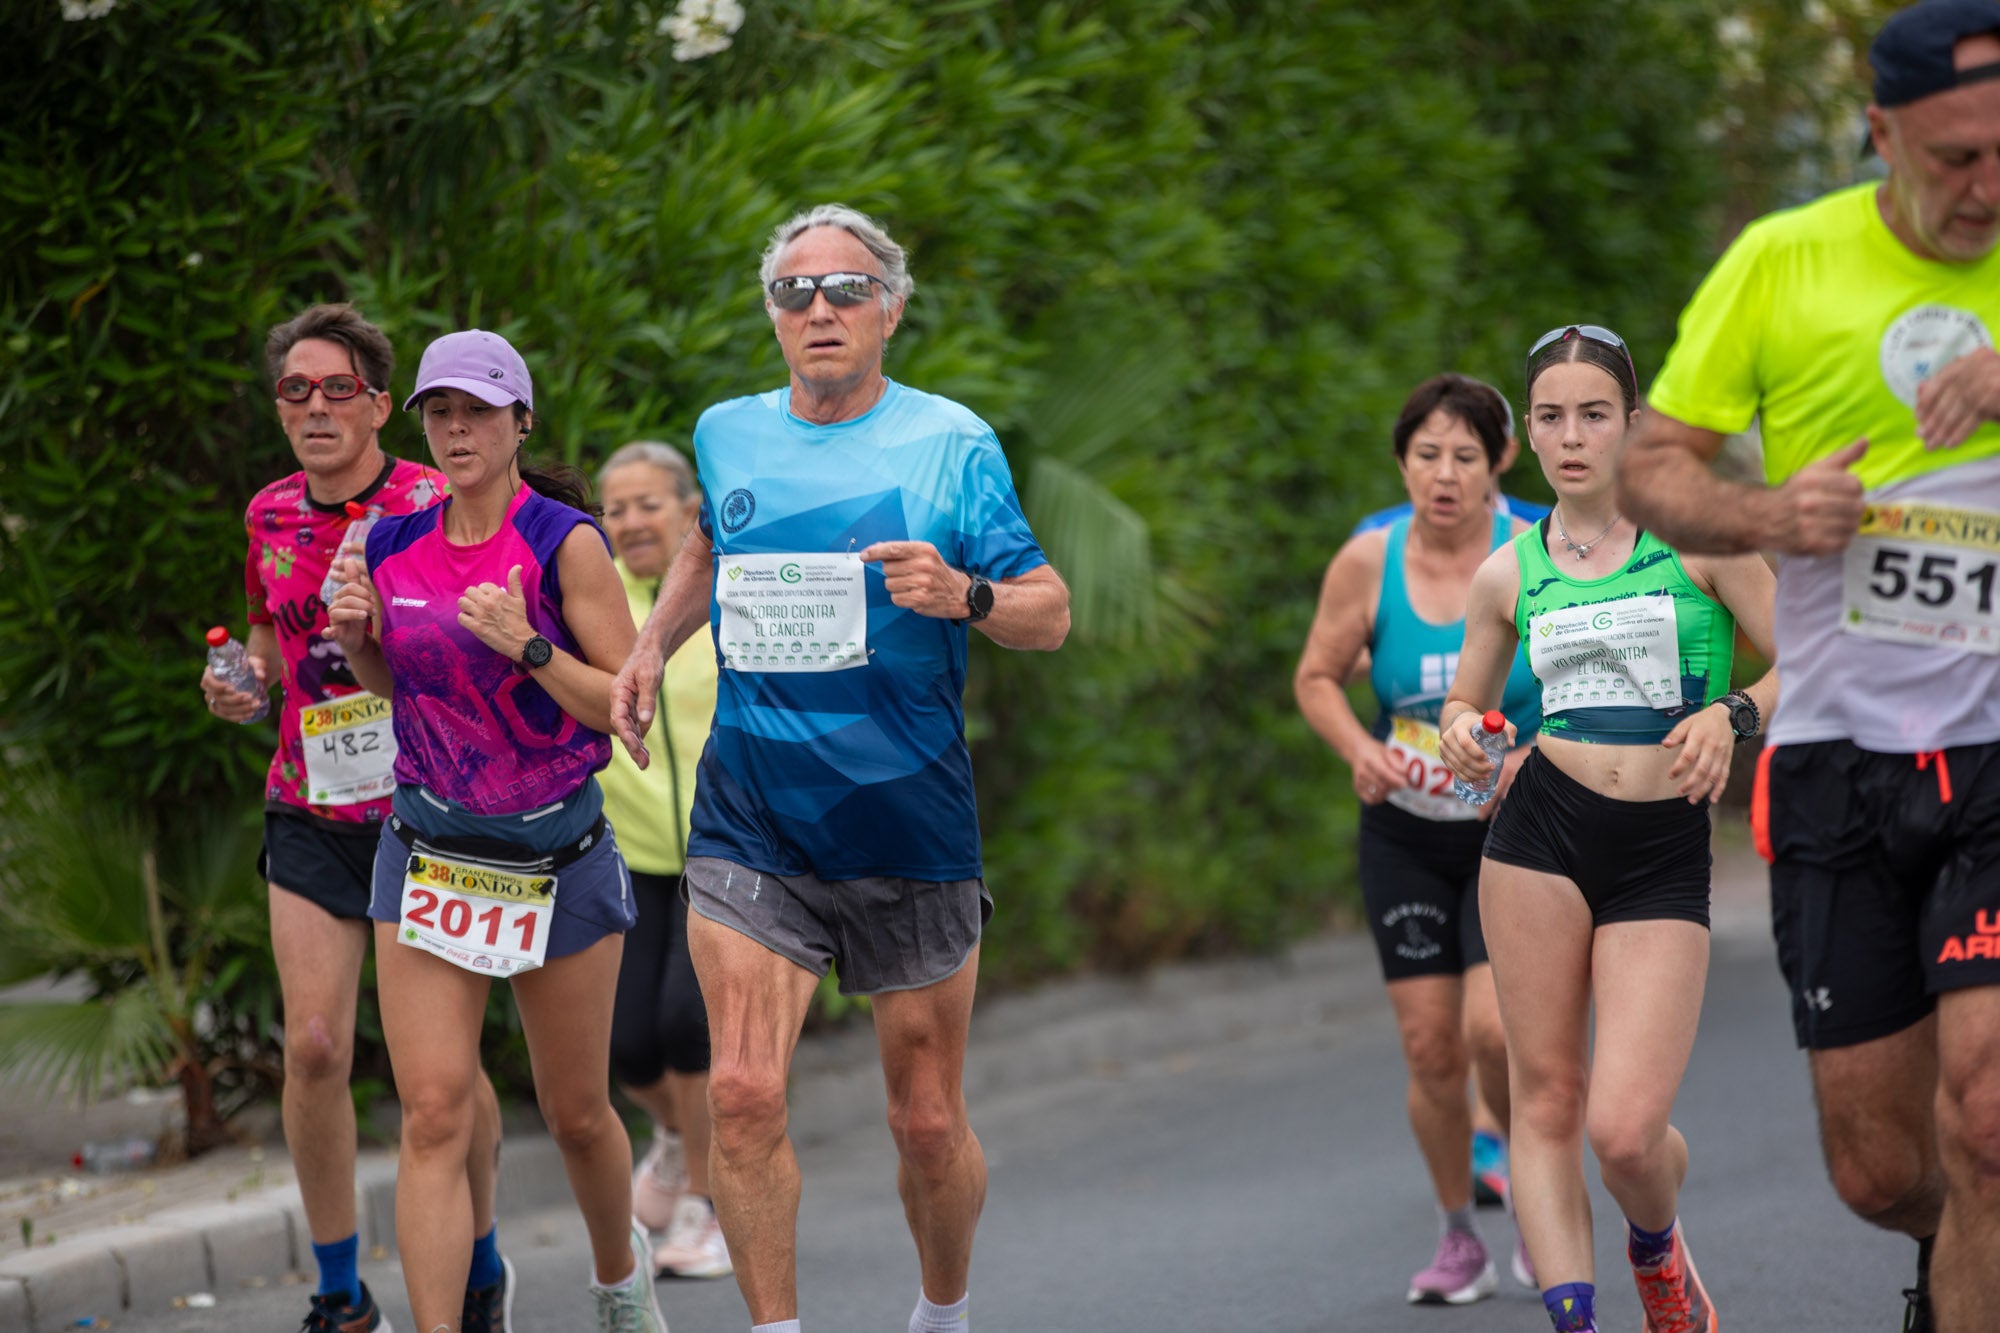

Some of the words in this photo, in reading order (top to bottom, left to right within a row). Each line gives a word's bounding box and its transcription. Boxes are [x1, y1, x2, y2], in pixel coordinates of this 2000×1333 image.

[1869, 546, 1997, 614] 551
[758, 589, 766, 598] DE
[766, 589, 785, 598] FONDO
[815, 589, 823, 597] DE
[823, 588, 848, 597] GRANADA
[750, 604, 788, 620] CORRO
[791, 604, 836, 619] CONTRA
[754, 622, 766, 638] EL
[769, 620, 816, 637] CÁNCER
[1555, 620, 1588, 632] Diputación
[1555, 629, 1564, 637] de
[1564, 625, 1589, 635] Granada
[1626, 631, 1634, 640] DE
[1634, 629, 1660, 639] GRANADA
[1577, 661, 1589, 676] EL
[315, 708, 333, 728] 38
[322, 731, 381, 765] 482
[428, 862, 451, 883] 38
[454, 865, 481, 878] GRAN
[481, 870, 517, 886] PREMIO
[450, 872, 523, 897] FONDO
[405, 888, 538, 952] 2011
